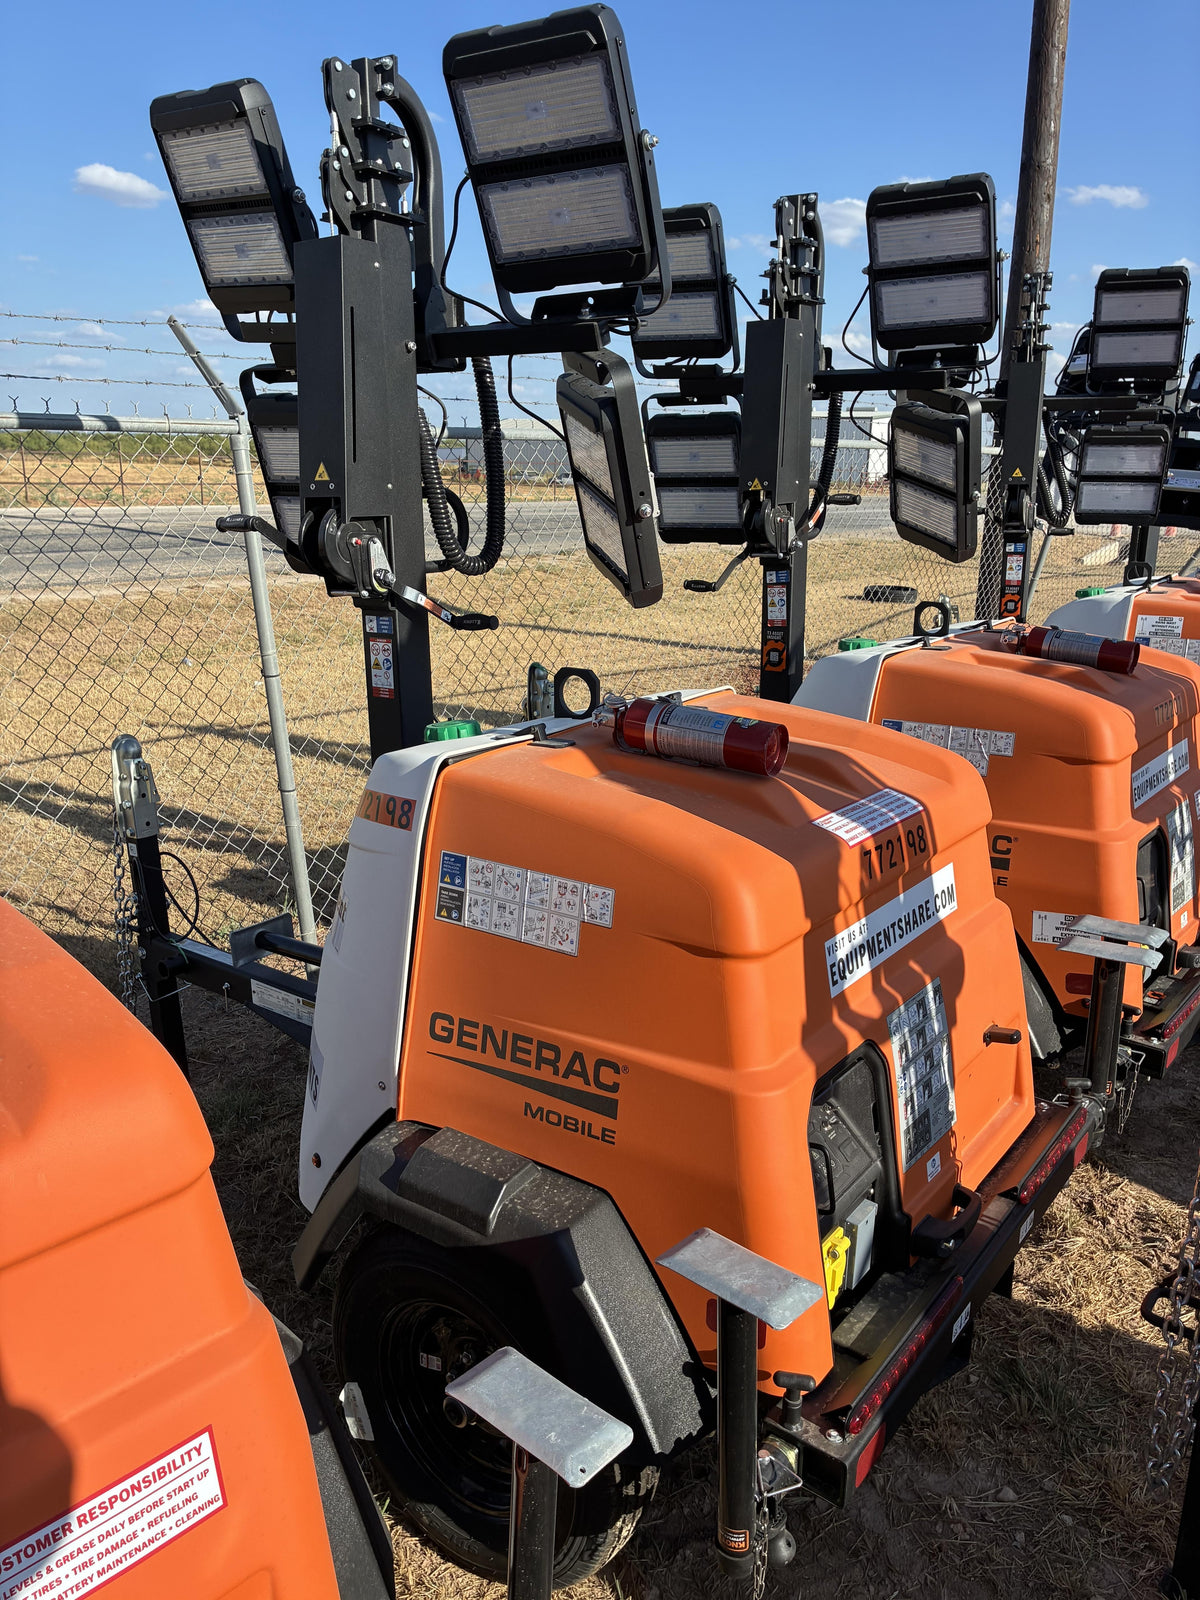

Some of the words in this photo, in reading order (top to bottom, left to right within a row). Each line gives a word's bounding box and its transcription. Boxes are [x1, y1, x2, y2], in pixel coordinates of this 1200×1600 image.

[360, 790, 413, 829] 2198
[863, 825, 927, 879] 772198
[827, 937, 845, 957] VISIT
[847, 930, 856, 943] US
[829, 883, 956, 987] EQUIPMENTSHARE.COM
[429, 1011, 621, 1094] GENERAC
[523, 1101, 617, 1145] MOBILE
[0, 1521, 74, 1576] STOMER
[76, 1442, 203, 1529] RESPONSIBILITY
[3, 1570, 44, 1600] LEVELS
[45, 1565, 54, 1576] &
[55, 1539, 96, 1568] GREASE
[97, 1520, 126, 1544] DAILY
[128, 1496, 165, 1526] BEFORE
[166, 1477, 195, 1500] START
[196, 1468, 210, 1482] UP
[31, 1577, 62, 1600] TIRES
[71, 1557, 96, 1576] TIRE
[97, 1529, 139, 1562] DAMAGE
[147, 1492, 199, 1530] REFUELING
[96, 1529, 168, 1579] MAINTENANCE
[175, 1494, 220, 1528] CLEANING
